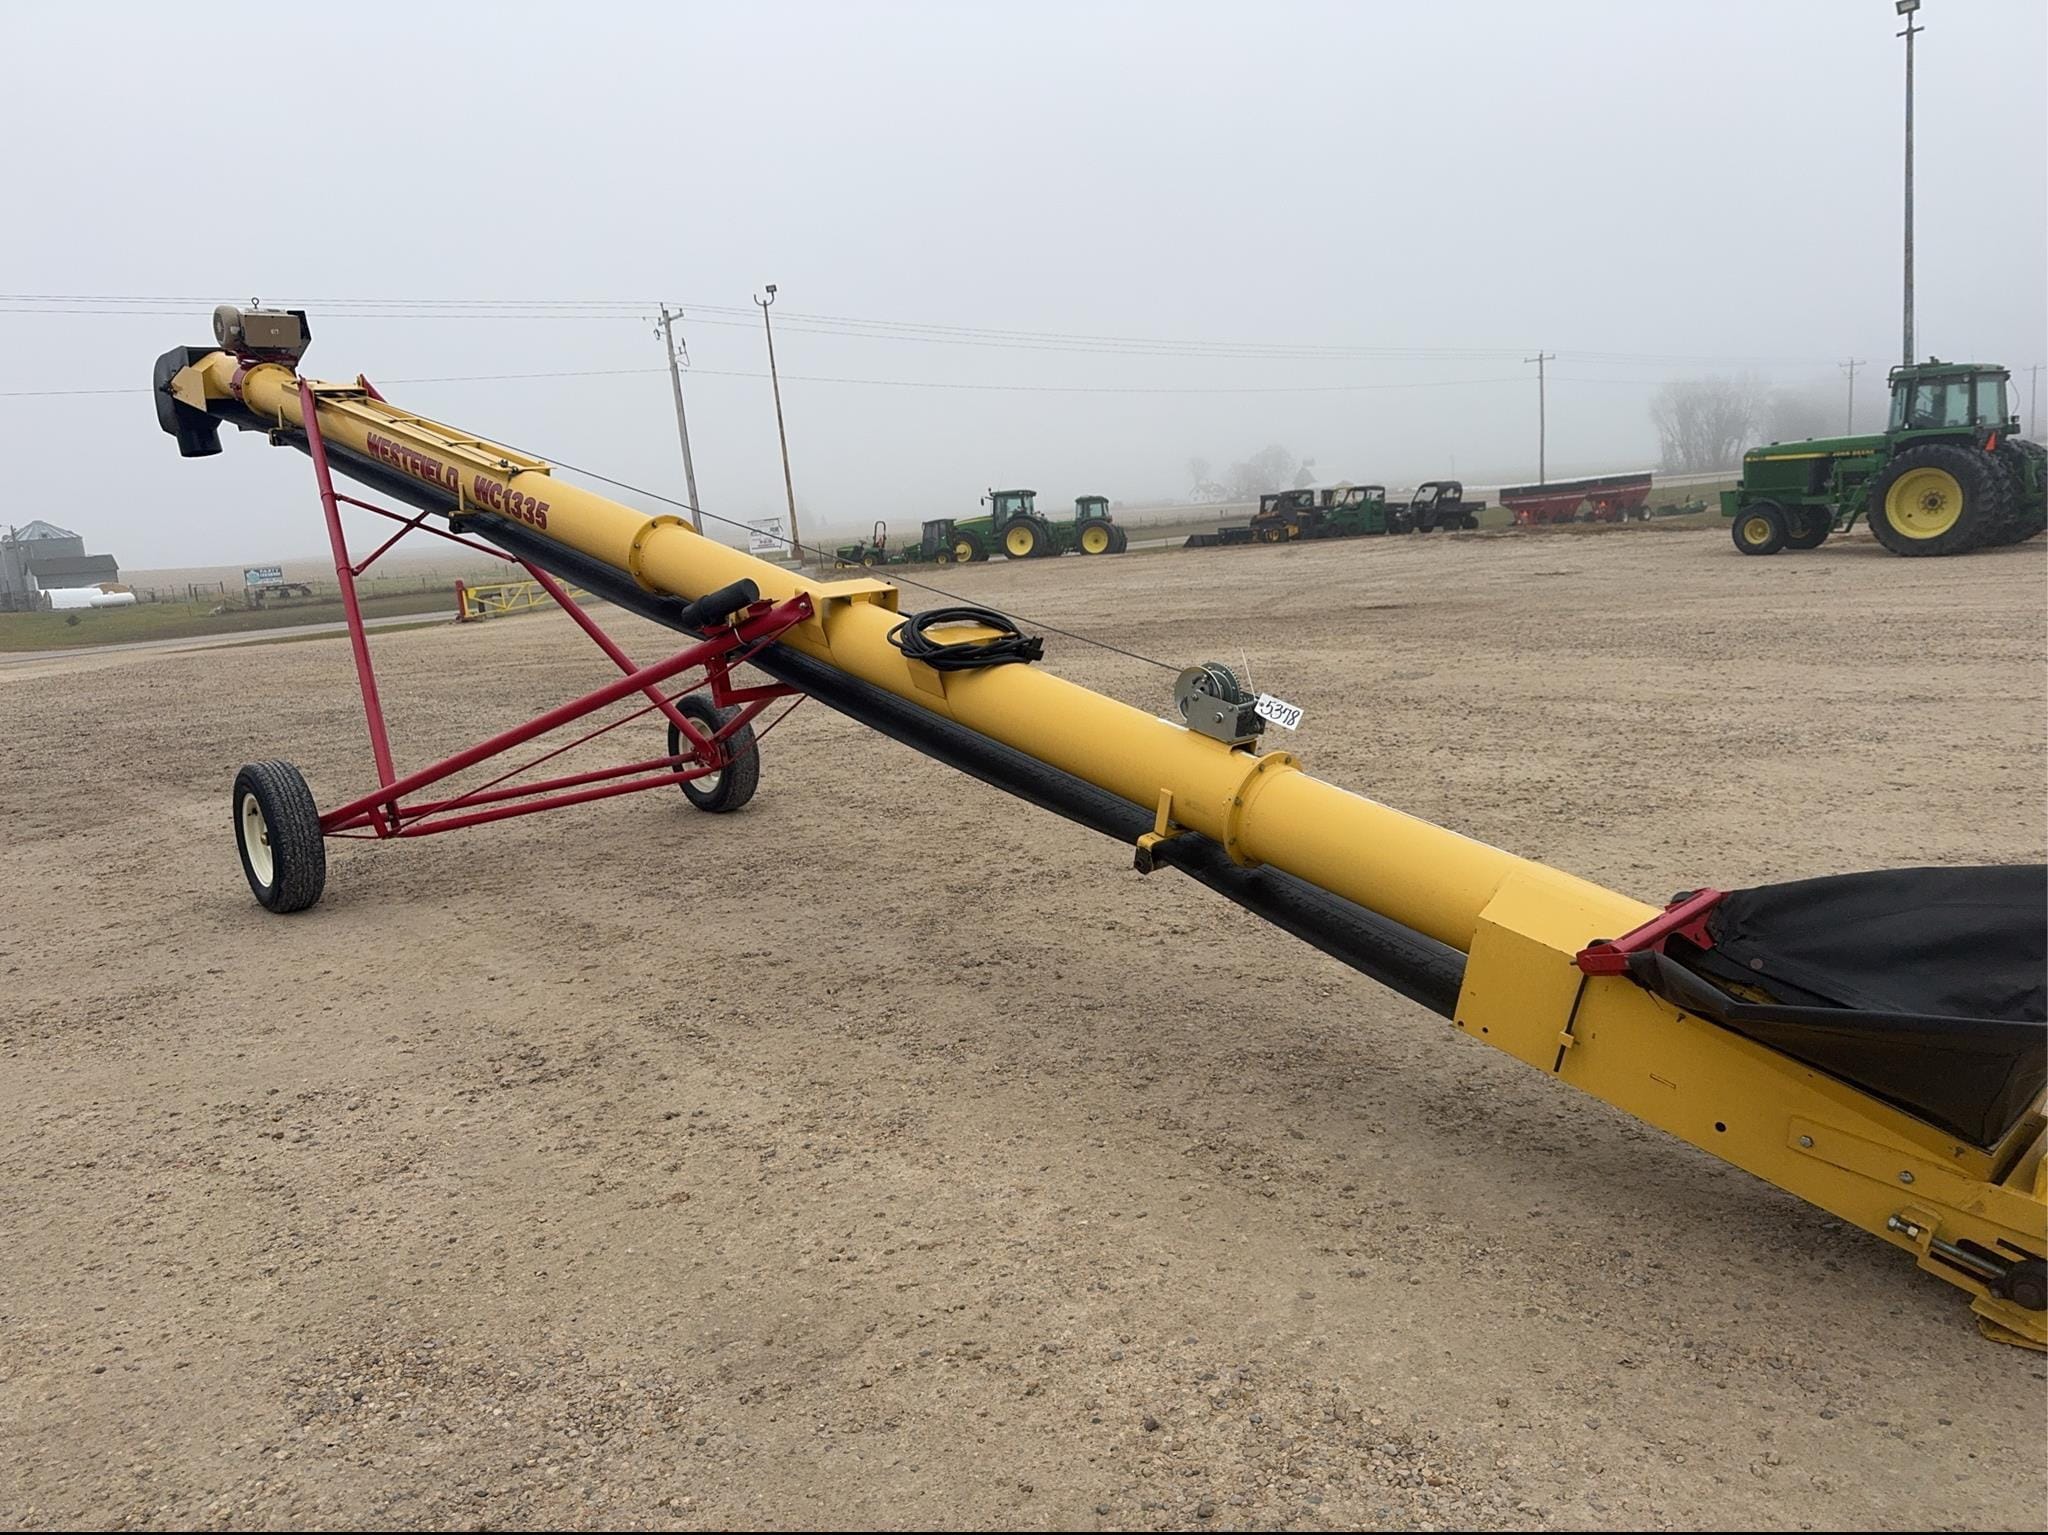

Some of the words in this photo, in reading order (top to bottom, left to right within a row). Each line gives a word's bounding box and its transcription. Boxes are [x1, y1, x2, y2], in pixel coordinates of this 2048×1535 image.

[366, 432, 459, 493] WESTFIELD
[473, 475, 551, 530] WC1335
[1260, 700, 1301, 726] 5378
